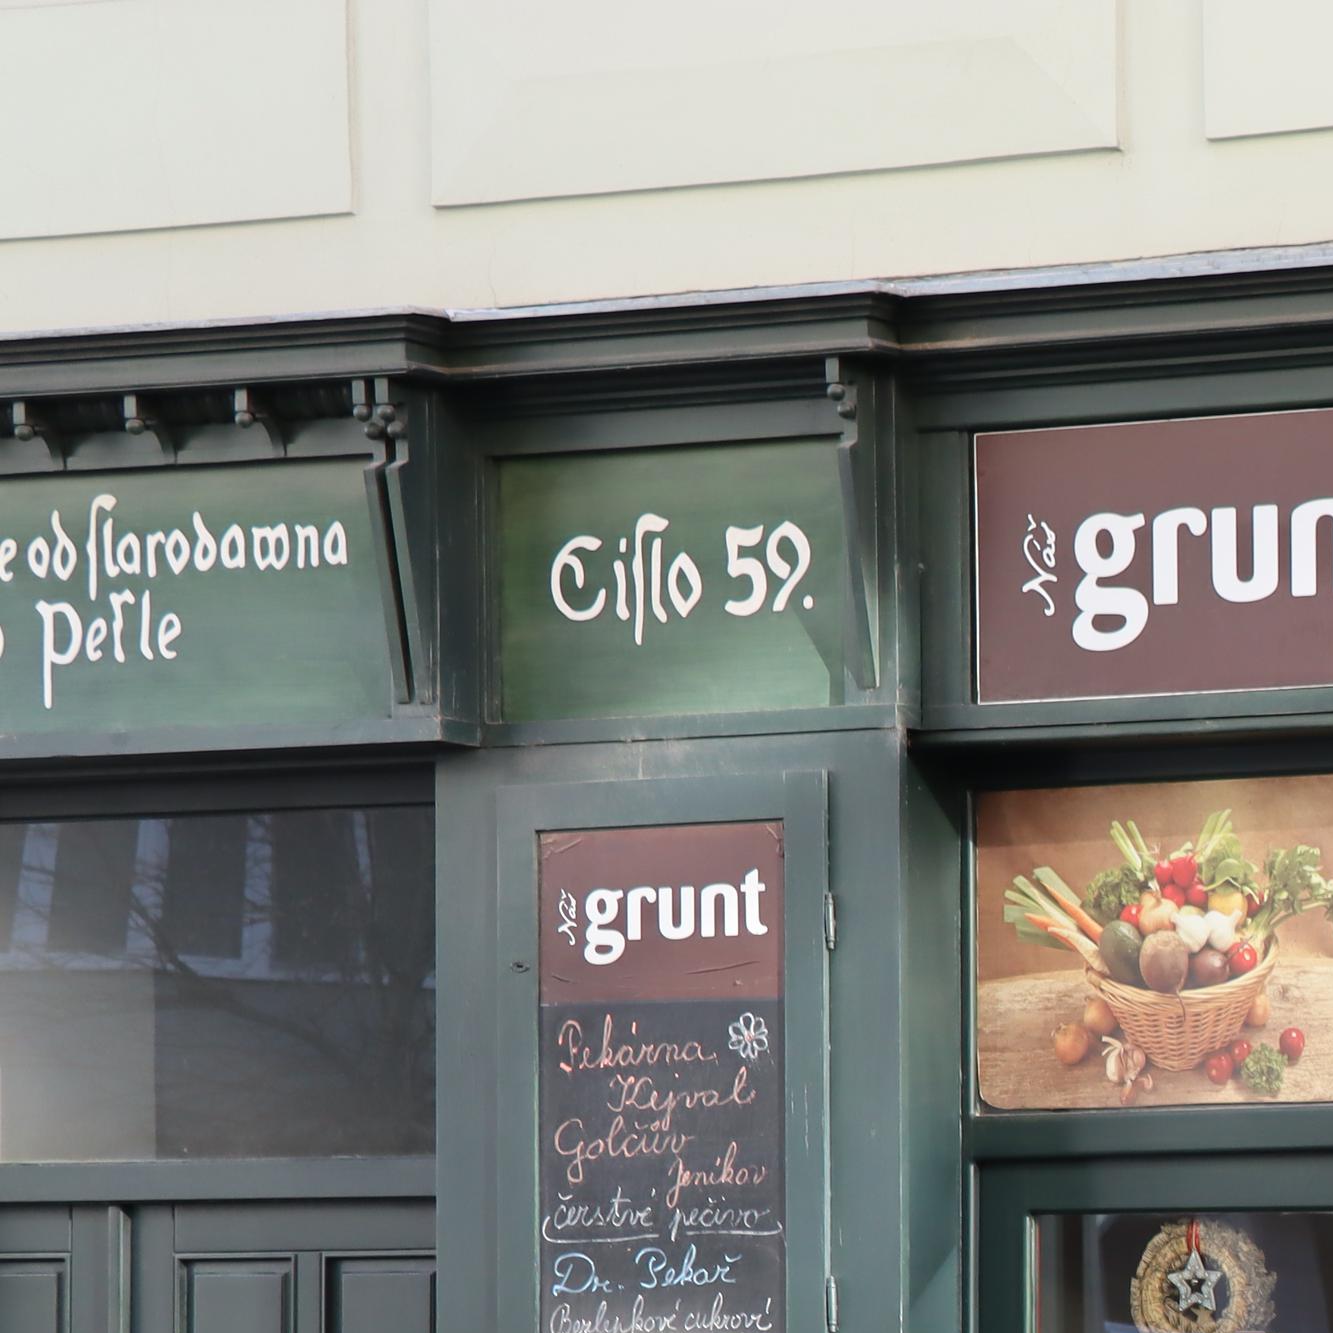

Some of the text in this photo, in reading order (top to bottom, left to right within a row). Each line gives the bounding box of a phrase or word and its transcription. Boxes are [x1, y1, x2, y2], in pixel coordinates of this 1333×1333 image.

[28, 510, 77, 581] od
[724, 521, 815, 616] 59.
[583, 868, 768, 965] grunt
[558, 1013, 719, 1072] Pekárna
[554, 1186, 771, 1241] čerstvé pečivo
